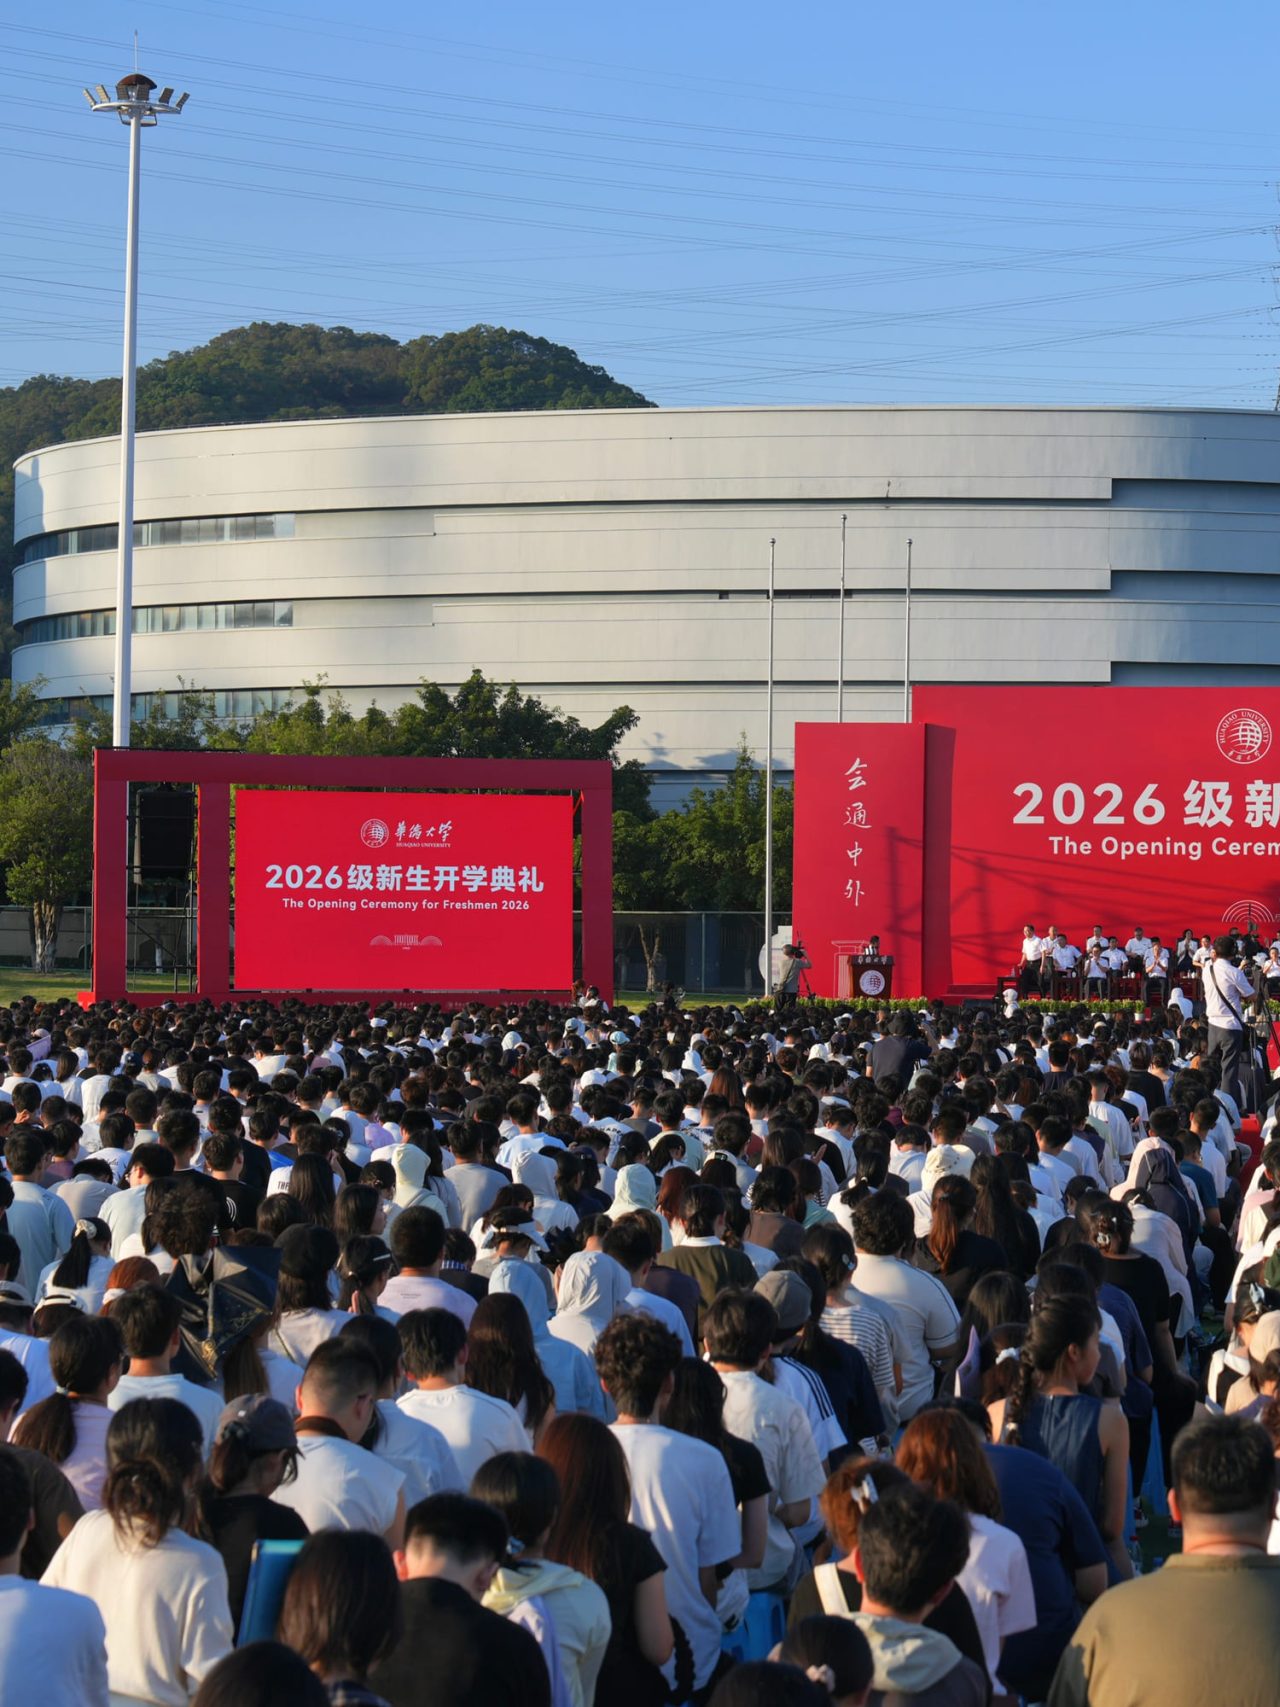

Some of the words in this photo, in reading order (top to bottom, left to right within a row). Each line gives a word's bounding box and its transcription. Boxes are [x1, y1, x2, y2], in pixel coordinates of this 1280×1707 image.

[844, 757, 872, 907] 会通中外
[1049, 836, 1092, 855] The
[1101, 836, 1202, 861] Opening
[265, 863, 545, 893] 2026级新生开学典礼
[282, 897, 304, 909] The
[307, 898, 357, 911] Opening
[360, 899, 419, 912] Ceremony
[422, 898, 440, 910] for
[443, 899, 498, 910] Freshmen
[501, 900, 530, 910] 2026
